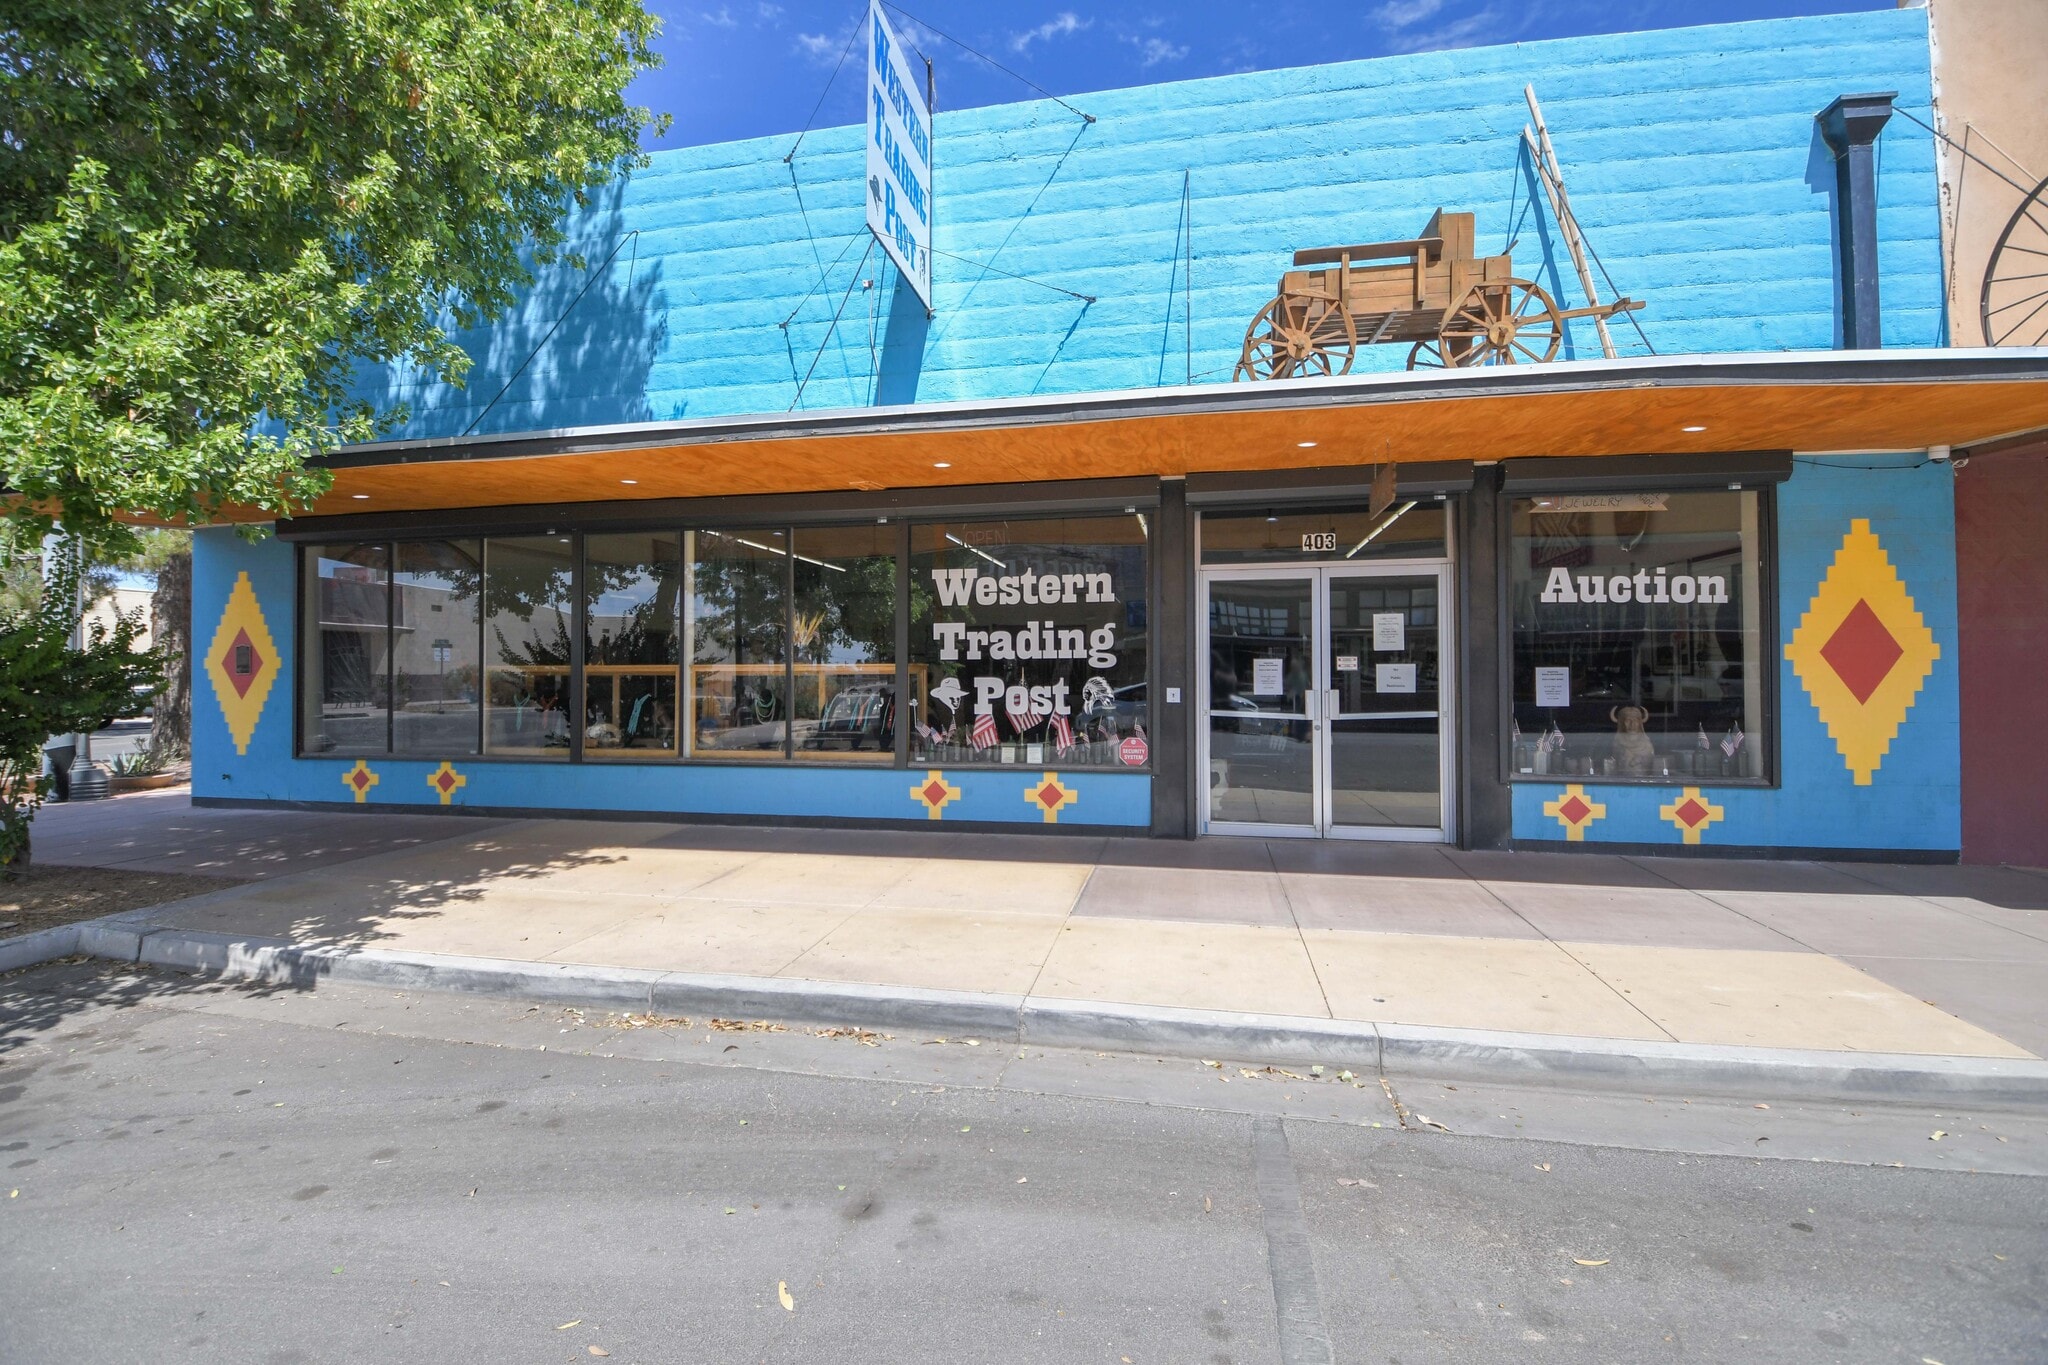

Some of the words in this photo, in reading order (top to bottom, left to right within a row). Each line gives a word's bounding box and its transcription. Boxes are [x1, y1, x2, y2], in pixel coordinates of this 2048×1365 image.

[1565, 497, 1623, 509] JEWELRY
[965, 529, 1006, 547] OPEN
[1303, 534, 1335, 550] 403
[932, 566, 1115, 606] Western
[1540, 566, 1729, 604] Auction
[932, 620, 1117, 669] Trading
[973, 676, 1071, 716] Post
